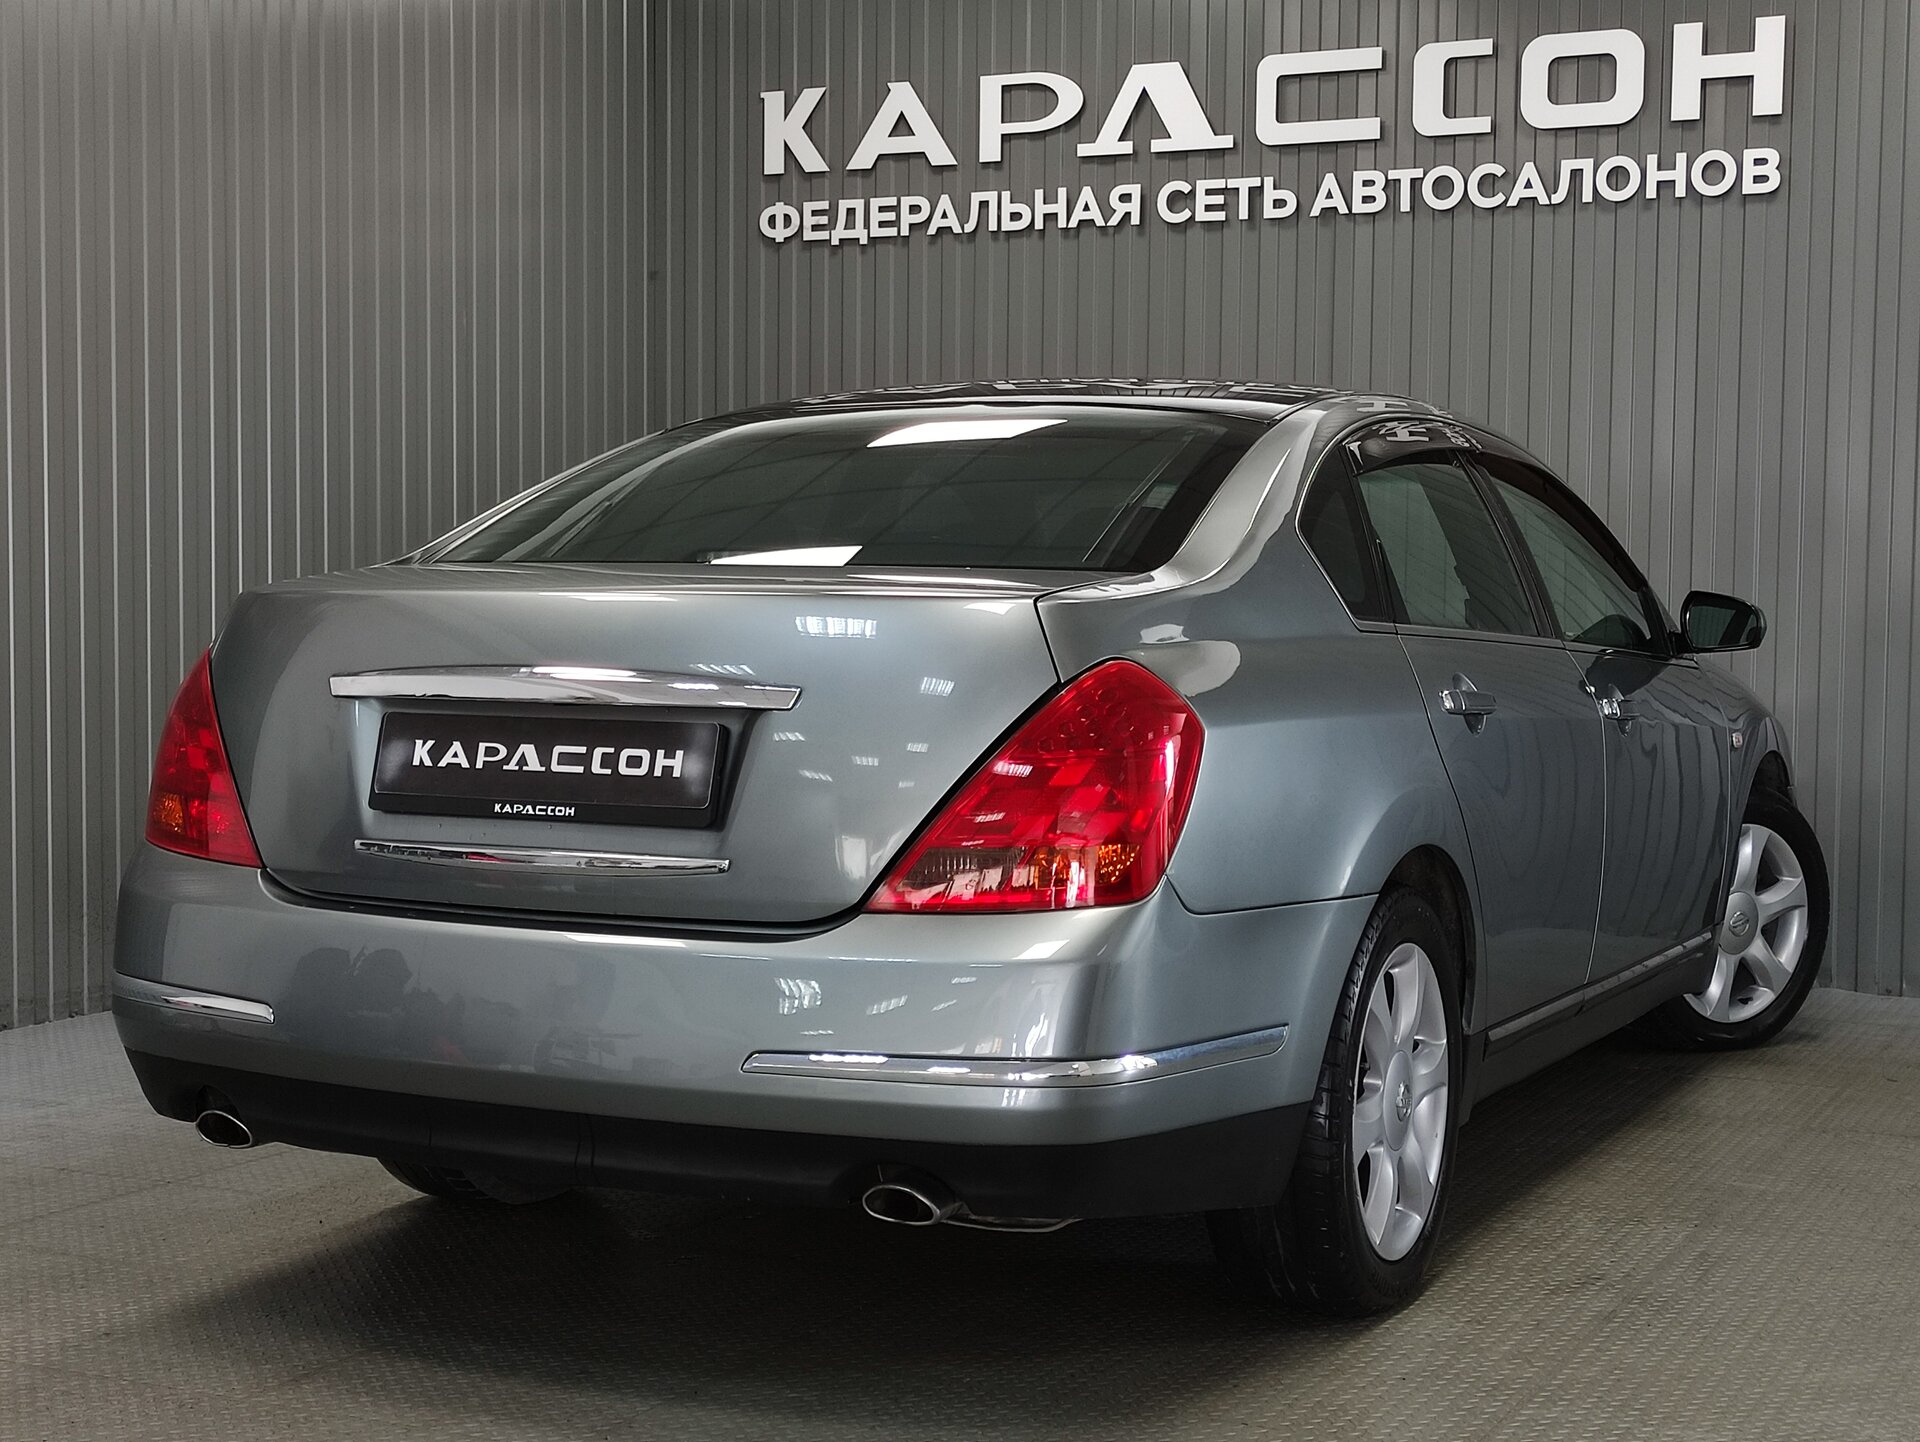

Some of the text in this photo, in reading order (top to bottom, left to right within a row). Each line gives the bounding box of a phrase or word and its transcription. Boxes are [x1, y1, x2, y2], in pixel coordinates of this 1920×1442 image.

[759, 147, 1782, 245] ФЕДЕРАЛЬНАЯ СЕТЬ АВТОСАЛОНОВ
